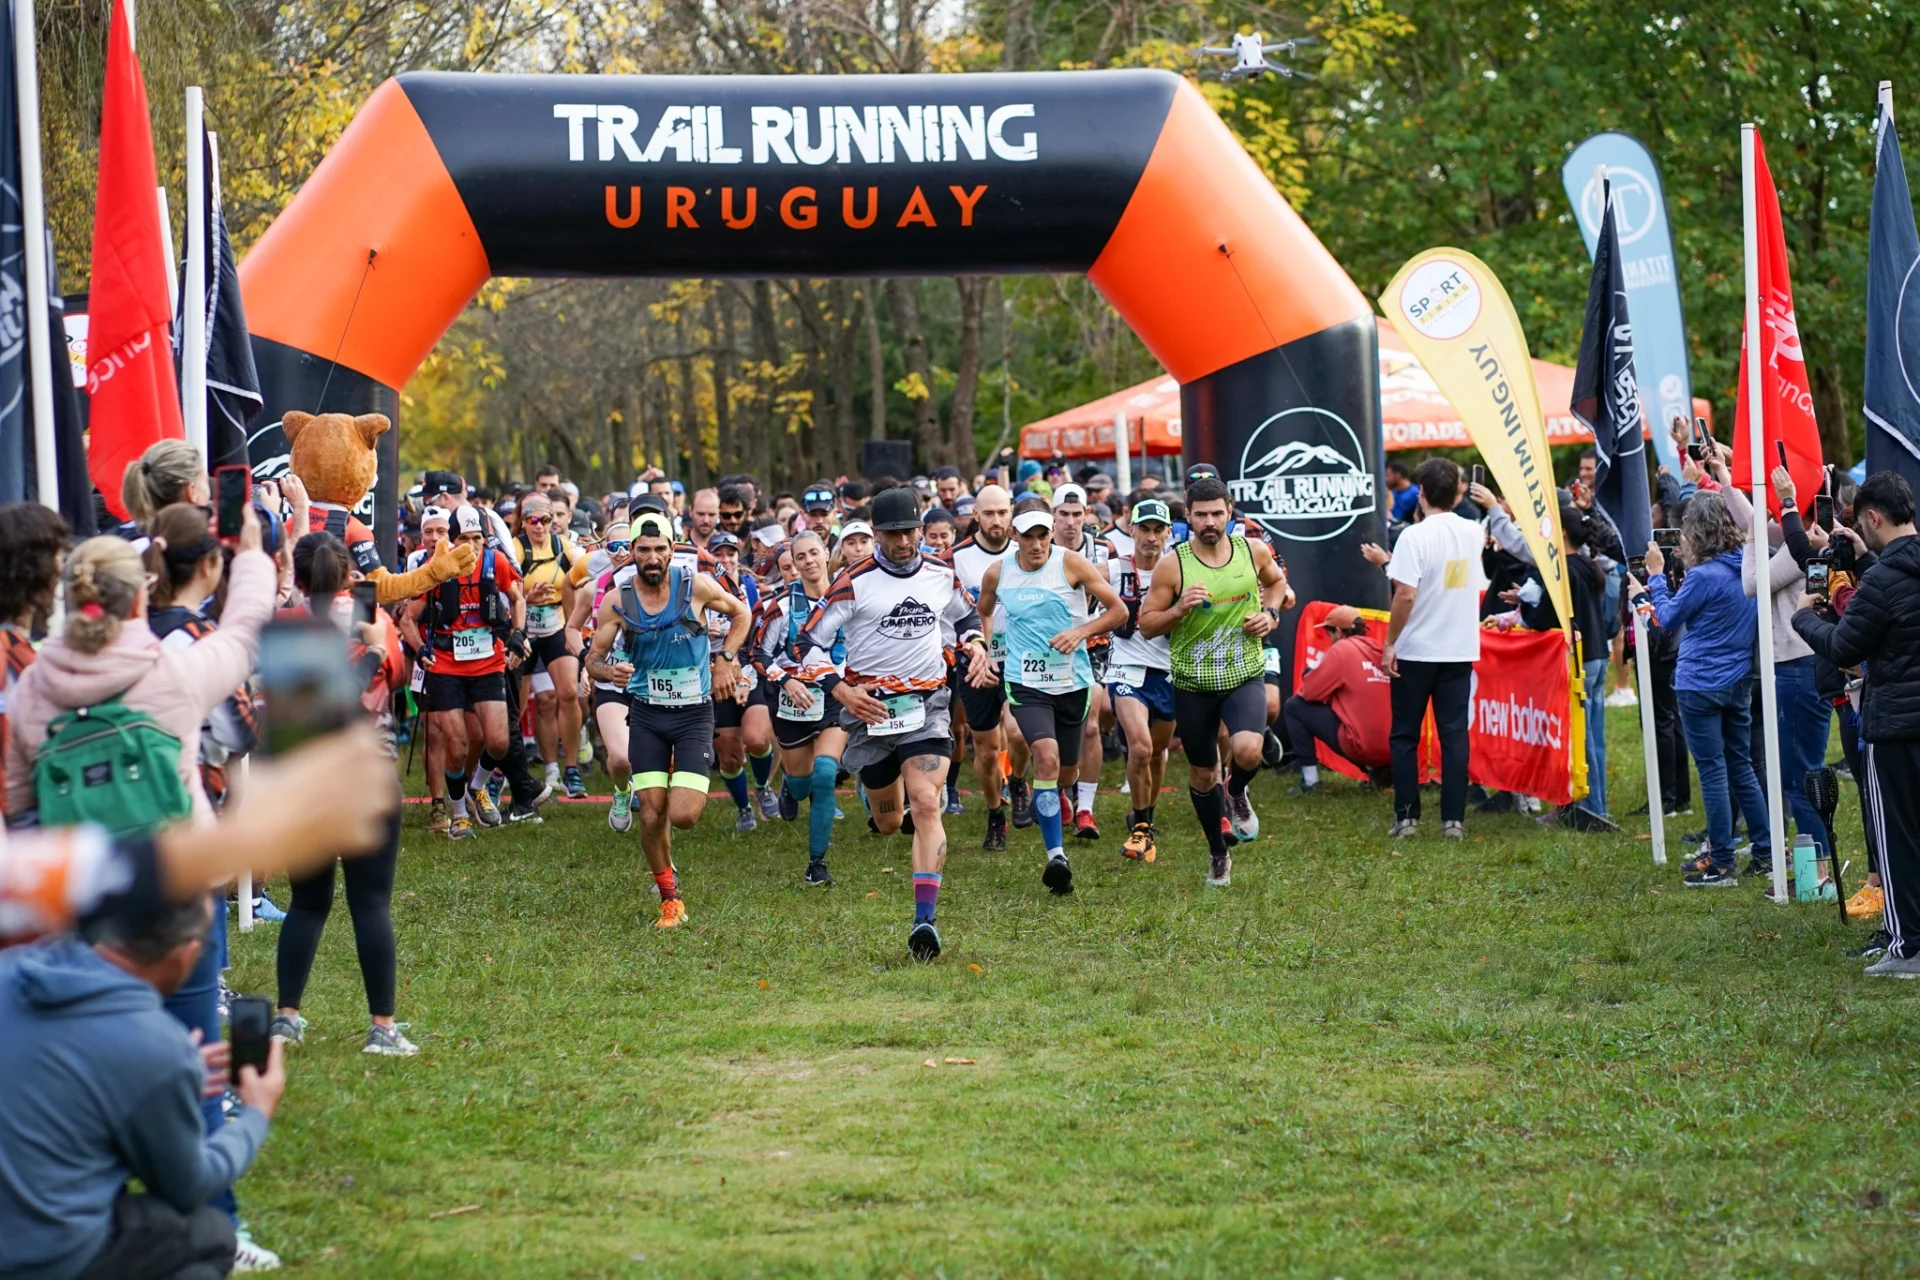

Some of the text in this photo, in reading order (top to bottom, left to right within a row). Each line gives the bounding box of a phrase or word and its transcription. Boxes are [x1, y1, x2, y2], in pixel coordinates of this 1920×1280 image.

[553, 104, 1038, 165] TRAIL RUNNING
[604, 184, 989, 229] URUGUAY
[1409, 271, 1462, 318] SPORT
[1231, 476, 1373, 502] TRAIL RUNNING
[1263, 497, 1354, 514] URUGUAY
[455, 635, 475, 647] 205
[1023, 659, 1046, 672] 223
[1040, 674, 1054, 682] 15K
[1114, 670, 1127, 679] 15K
[651, 678, 673, 692] 165
[668, 691, 683, 699] 15K
[793, 709, 806, 718] 15K
[1479, 698, 1509, 737] new
[889, 720, 905, 729] 15K
